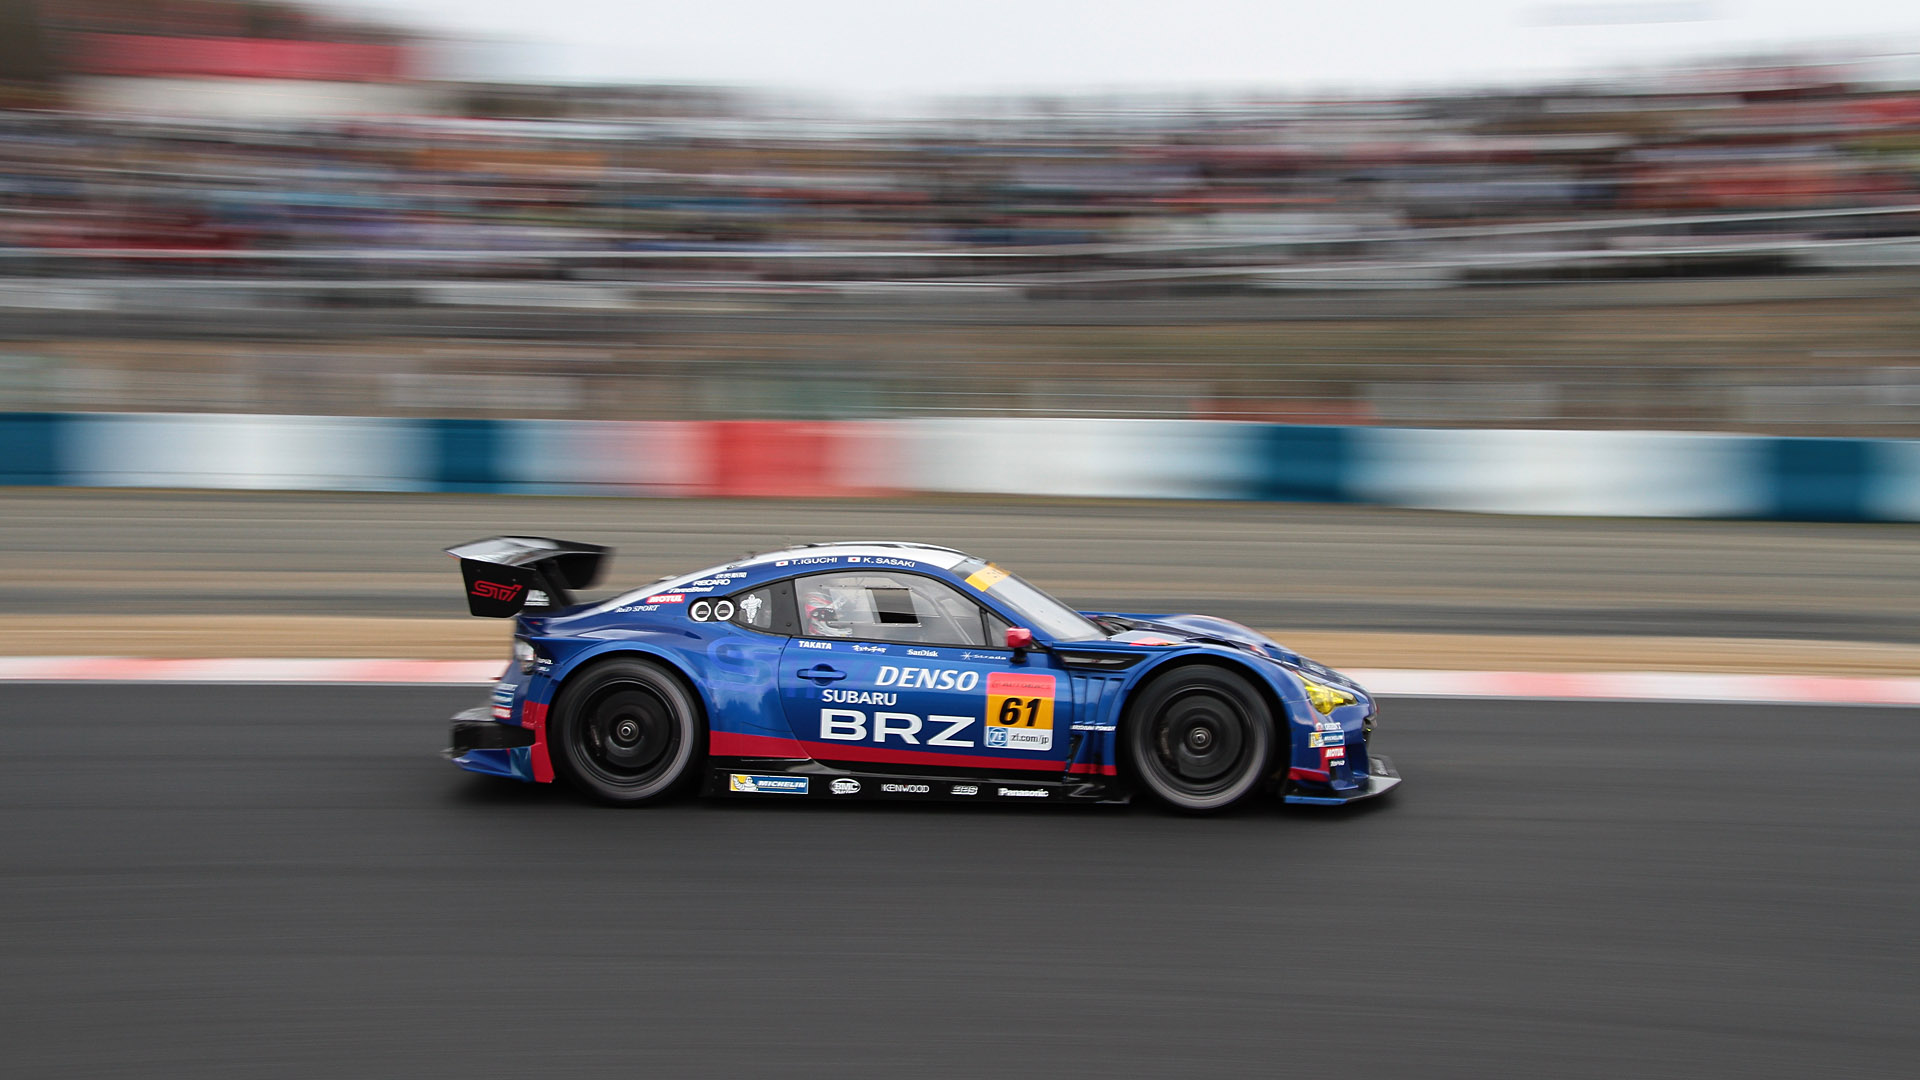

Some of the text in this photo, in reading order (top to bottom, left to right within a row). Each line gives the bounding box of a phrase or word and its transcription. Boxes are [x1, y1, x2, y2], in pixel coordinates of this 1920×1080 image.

[792, 557, 838, 566] T.IGUCHI
[876, 558, 916, 568] SASAKI
[648, 595, 683, 603] MOTUL
[798, 641, 832, 650] TAKATA
[907, 649, 938, 657] SanDisk
[874, 665, 979, 692] DENSO
[821, 689, 898, 706] SUBARU
[999, 697, 1042, 727] 61
[819, 708, 976, 748] BRZ
[1011, 734, 1049, 744] zf.com/jp
[757, 780, 807, 788] MICHELIN
[834, 782, 859, 790] BMC
[882, 783, 930, 793] KENWOOD
[998, 788, 1049, 797] Panasonic
